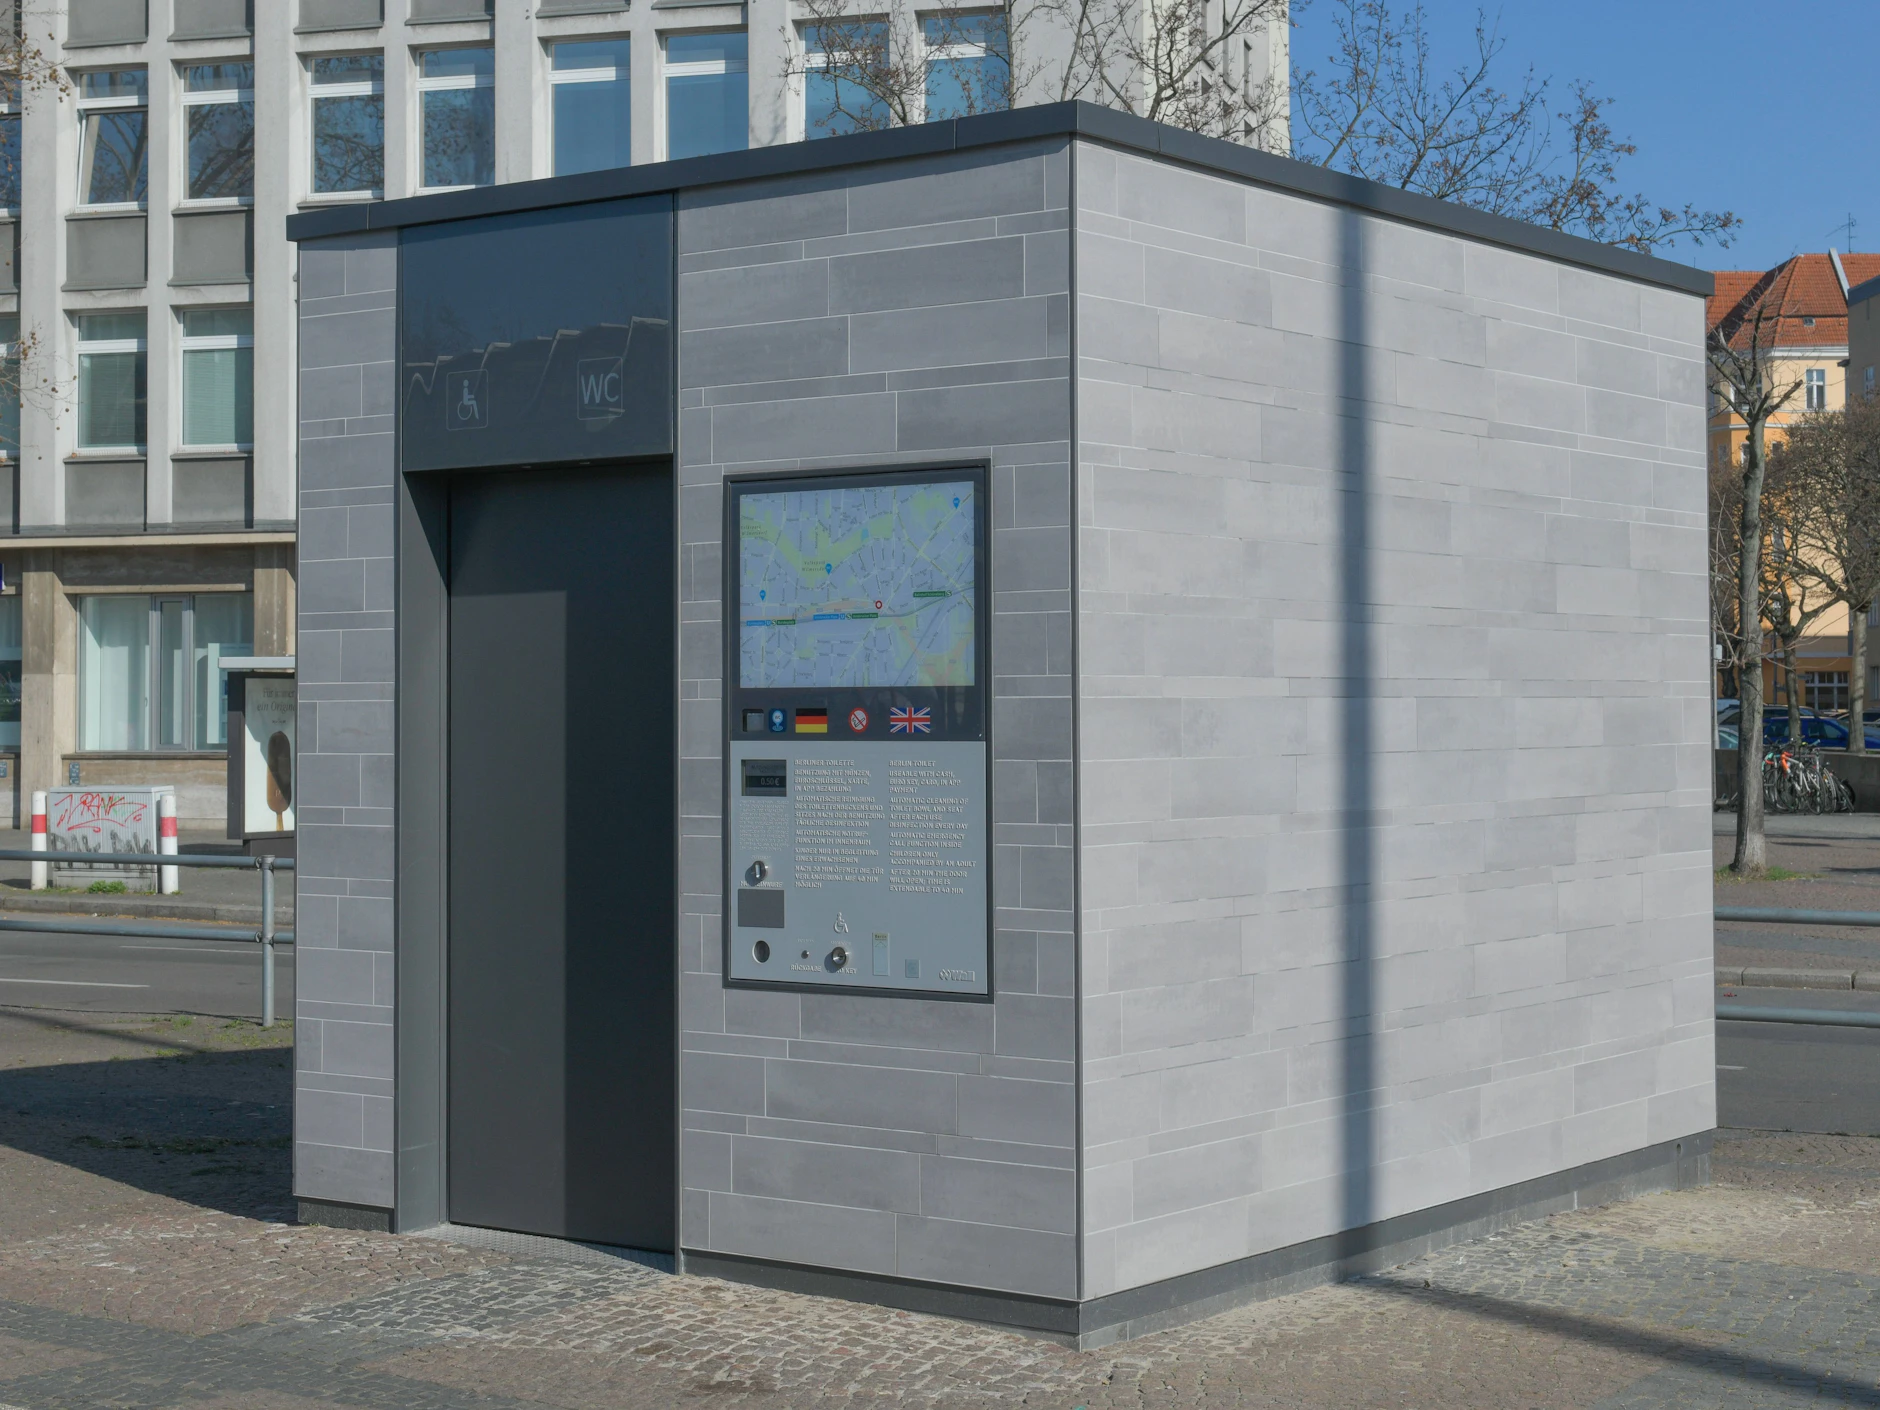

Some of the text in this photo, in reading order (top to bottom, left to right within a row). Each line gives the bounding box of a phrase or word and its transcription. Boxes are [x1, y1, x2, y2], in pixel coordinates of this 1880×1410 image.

[581, 373, 619, 404] WC
[774, 778, 780, 786] €
[834, 865, 858, 873] ÖFFNET
